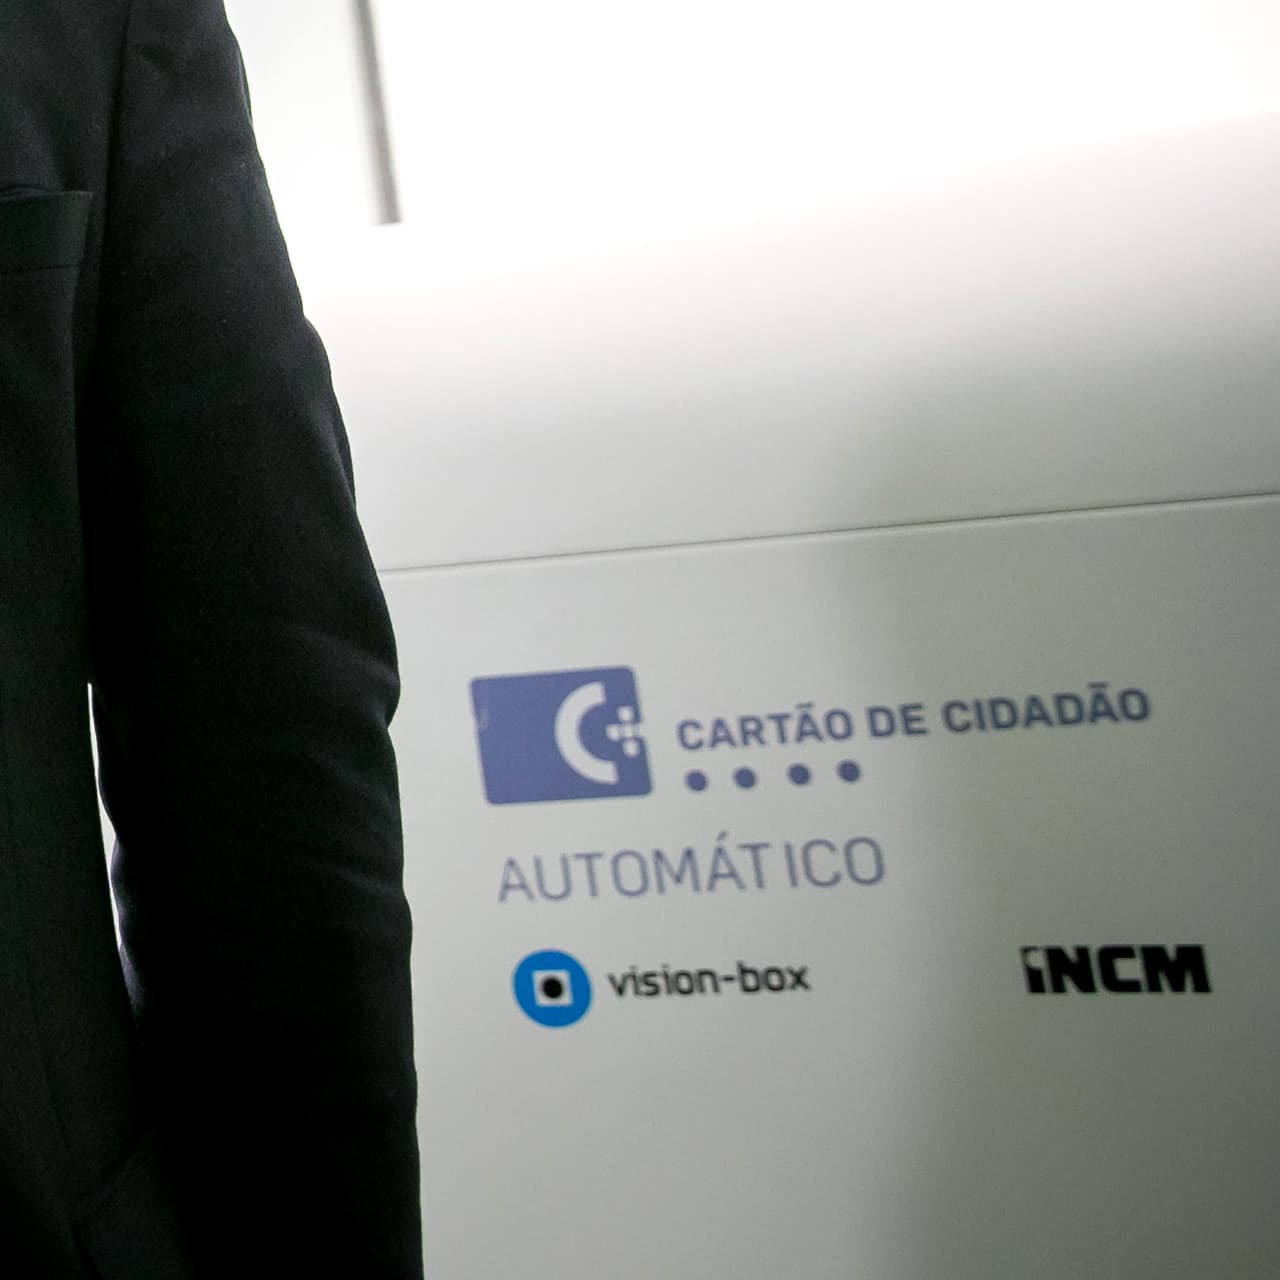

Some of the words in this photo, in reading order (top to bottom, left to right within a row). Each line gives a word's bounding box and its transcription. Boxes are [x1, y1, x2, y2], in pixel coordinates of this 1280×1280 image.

[677, 702, 855, 751] CARTÃO
[866, 703, 929, 738] DE
[942, 683, 1150, 734] CIDADÃO
[498, 831, 887, 904] AUTOMÁTICO
[608, 961, 812, 1000] vision-box
